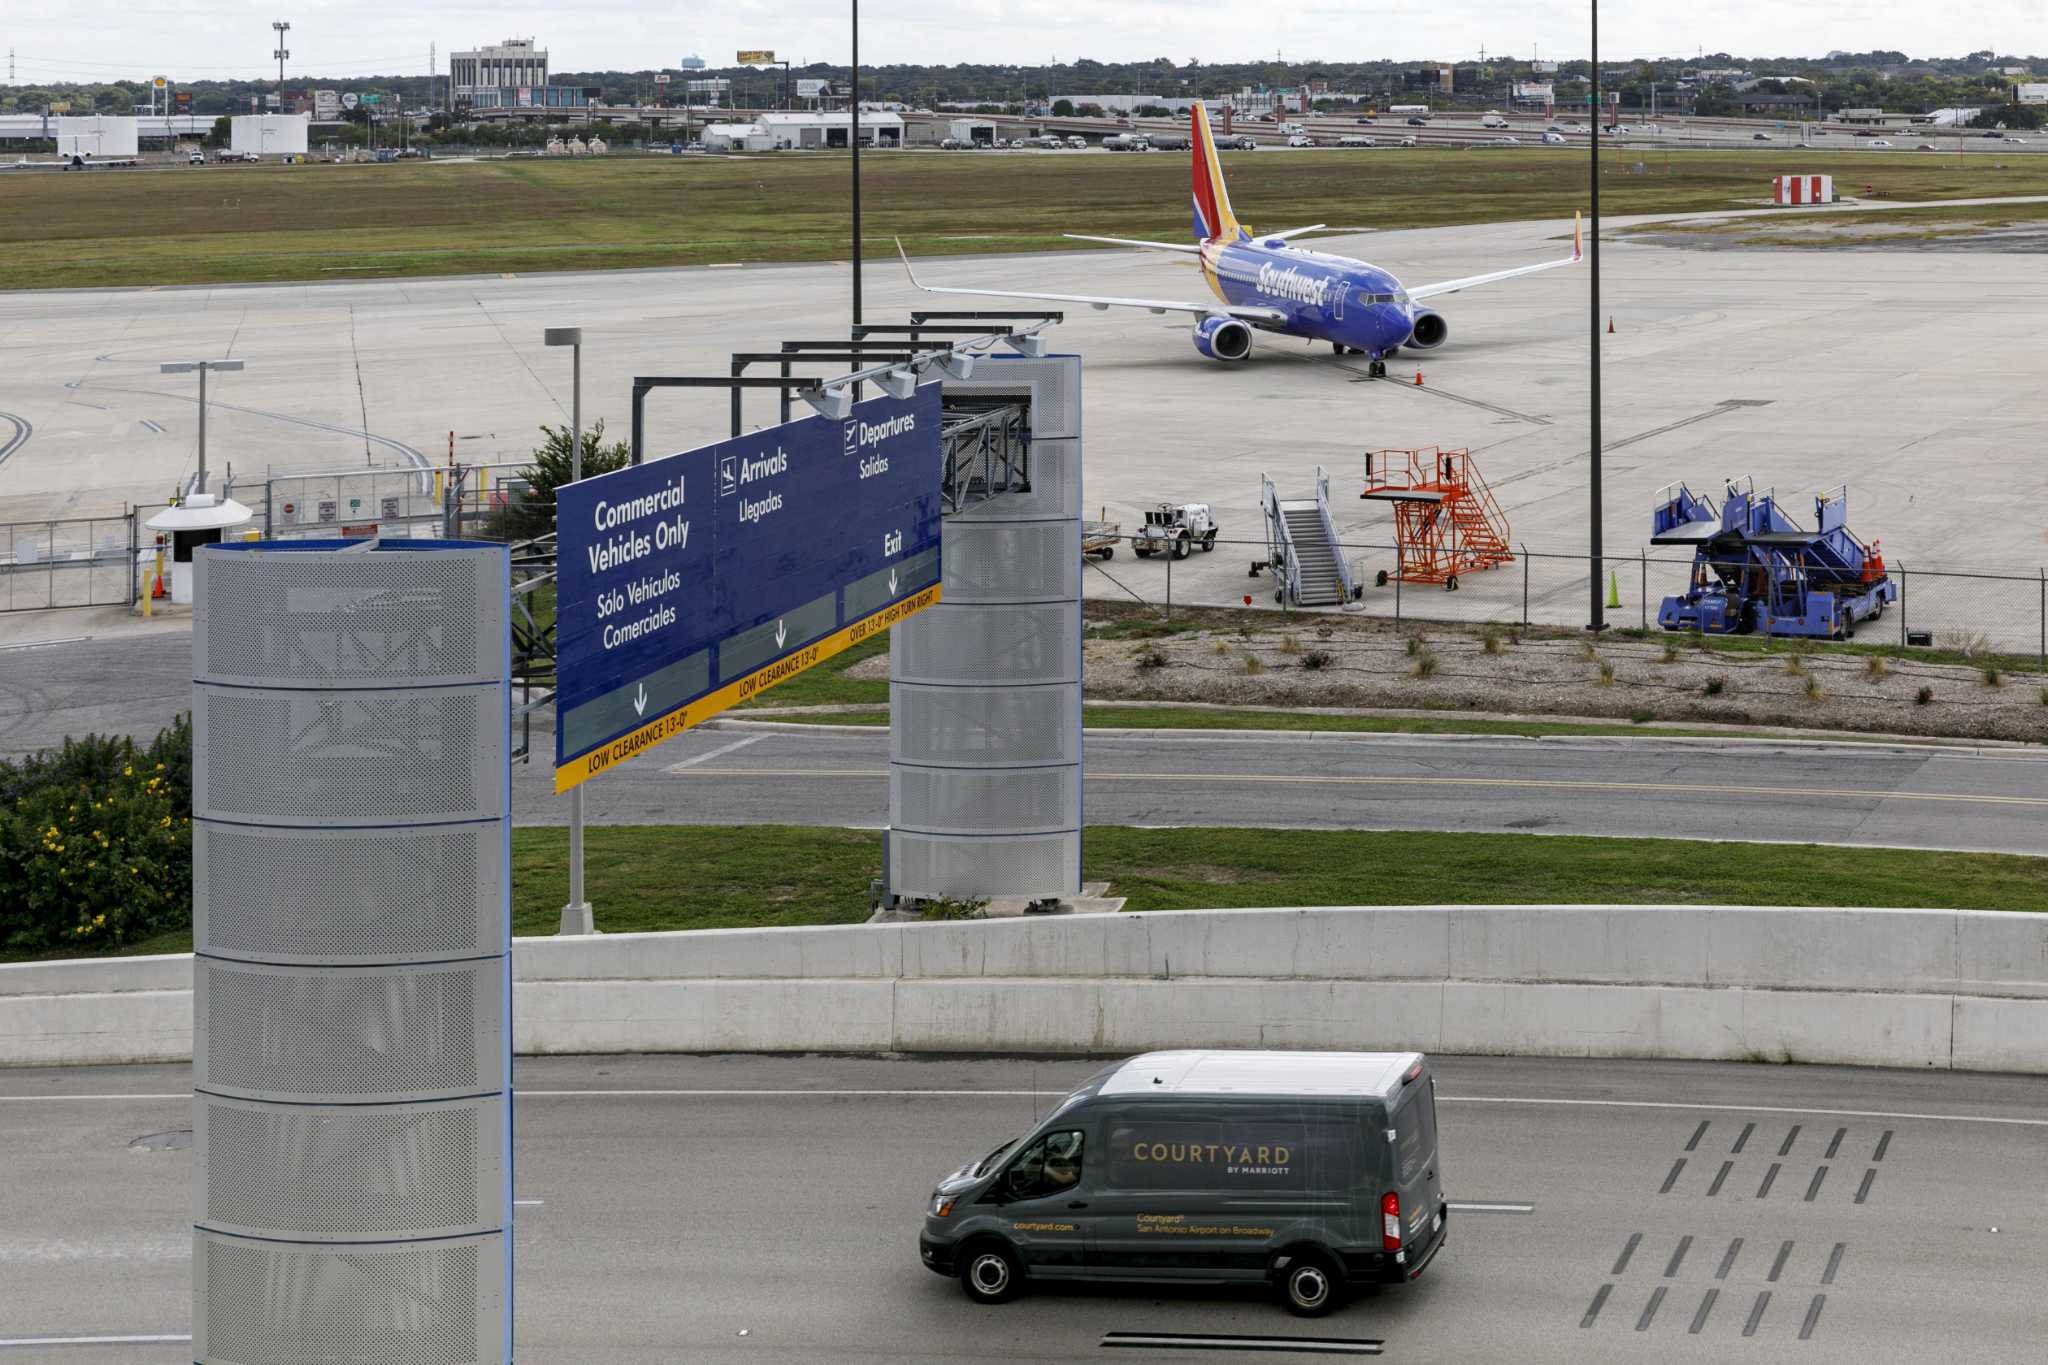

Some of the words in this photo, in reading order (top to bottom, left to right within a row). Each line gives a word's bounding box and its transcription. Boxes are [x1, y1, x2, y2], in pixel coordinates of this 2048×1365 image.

[1255, 261, 1330, 307] Southwest
[859, 413, 914, 448] Departures
[740, 446, 787, 485] Arrivals
[859, 453, 889, 479] Salidas
[595, 475, 685, 531] Commercial
[739, 490, 782, 523] Llegadas
[588, 530, 651, 574] Vehicles
[655, 514, 690, 549] Only
[884, 529, 902, 557] Exit
[597, 588, 624, 619] Sólo
[627, 568, 681, 606] Vehículos
[603, 604, 676, 650] Comerciales
[849, 622, 867, 642] OVER
[884, 605, 900, 625] HIGH
[901, 598, 916, 617] TURN
[916, 590, 934, 609] RIGHT
[739, 676, 757, 698] LOW
[758, 655, 800, 688] CLEARANCE
[588, 748, 610, 774] LOW
[612, 722, 664, 761] CLEARANCE
[1134, 1142, 1290, 1165] COURTYARD
[1227, 1166, 1239, 1174] BY
[1241, 1167, 1290, 1175] MARRIOTT
[1013, 1221, 1073, 1232] courtyard.com
[1136, 1223, 1152, 1233] San
[1154, 1224, 1187, 1233] Antonio
[1188, 1225, 1217, 1236] Airport
